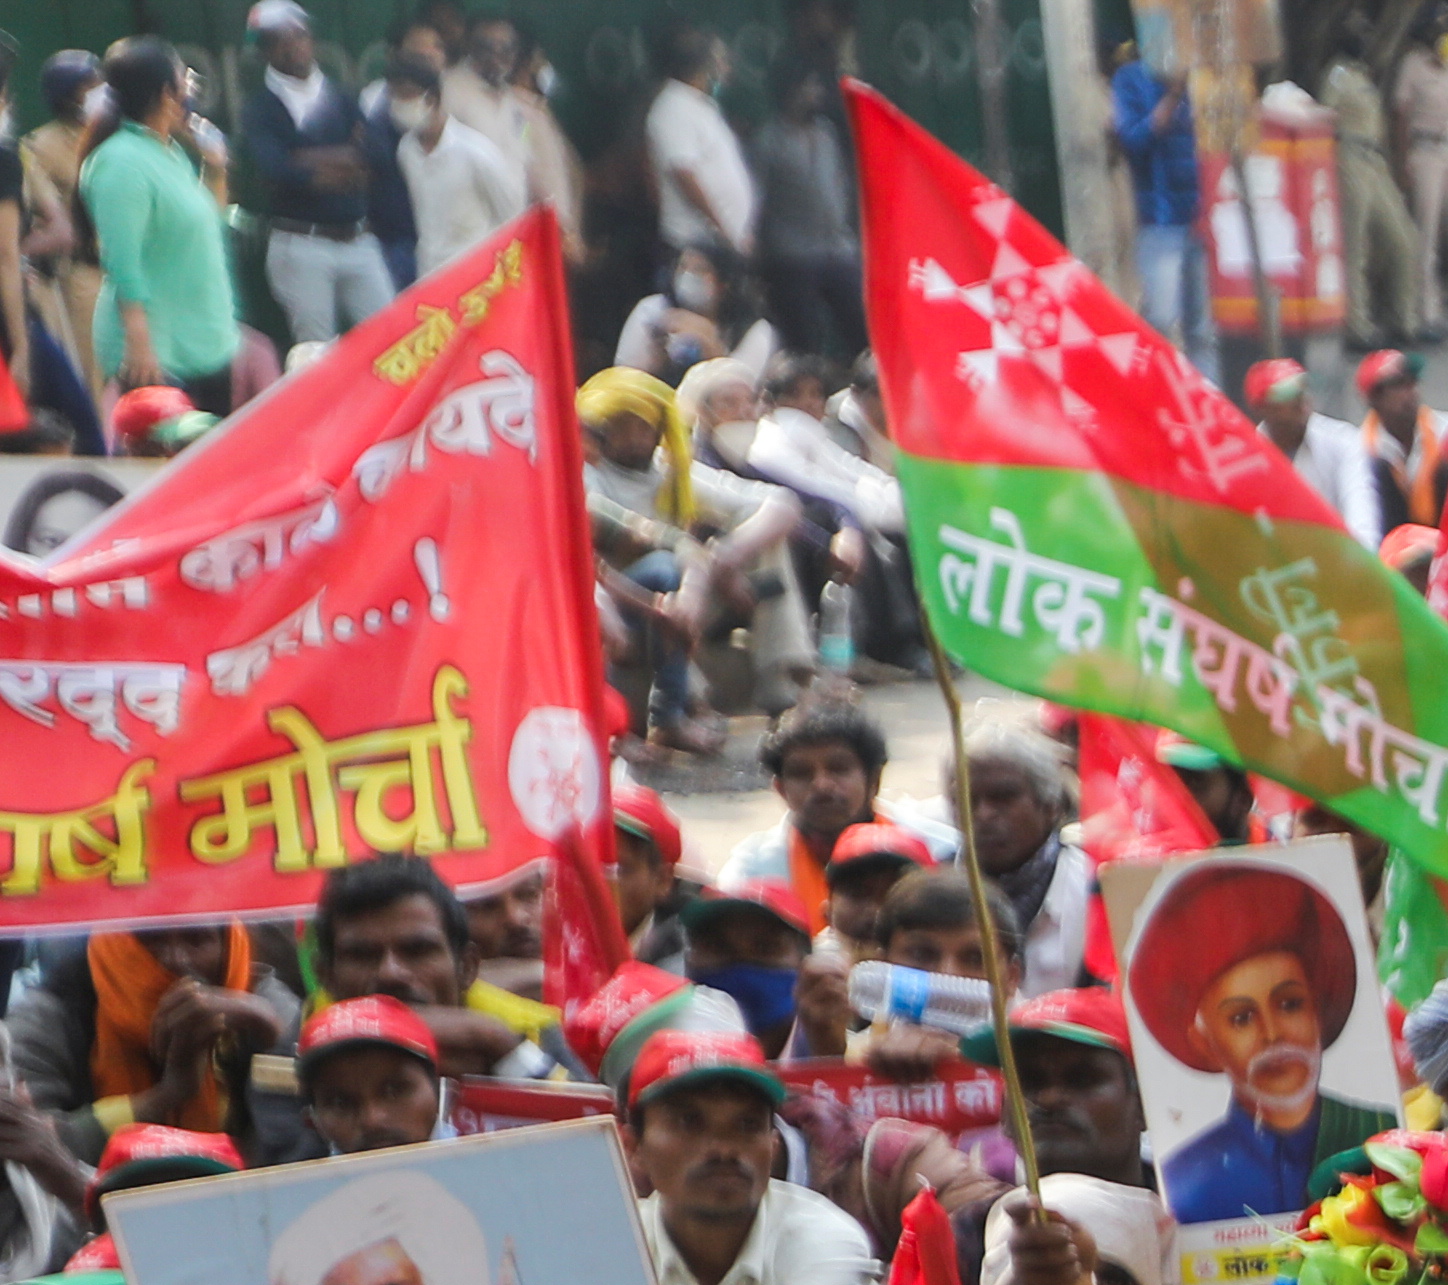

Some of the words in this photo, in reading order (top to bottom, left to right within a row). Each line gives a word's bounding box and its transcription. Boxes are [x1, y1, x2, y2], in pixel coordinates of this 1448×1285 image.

[939, 507, 1120, 652] लोक
[1136, 577, 1302, 737] संघर्ष
[180, 663, 488, 874] मोर्चा
